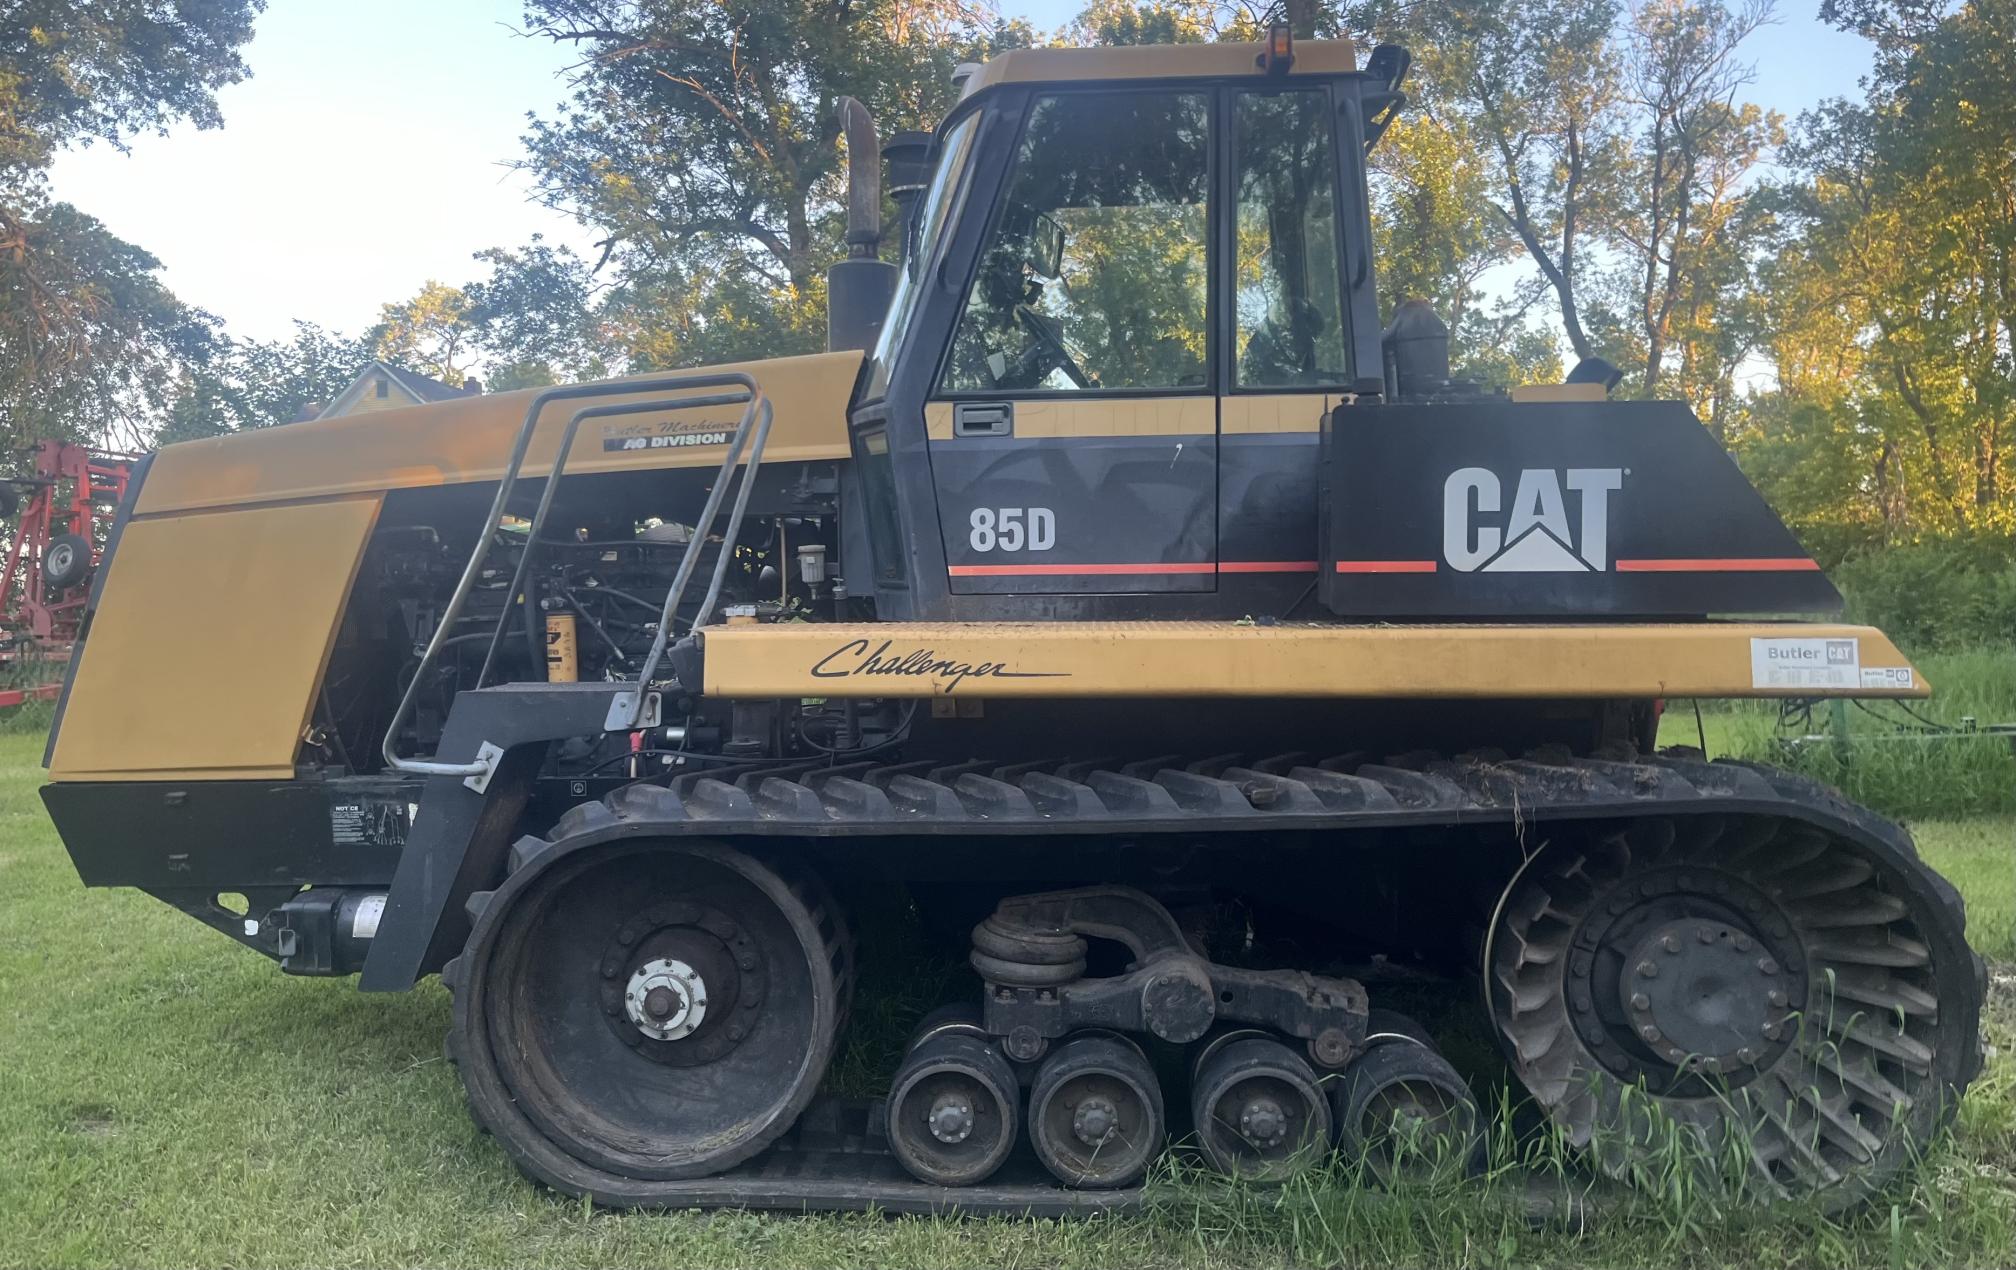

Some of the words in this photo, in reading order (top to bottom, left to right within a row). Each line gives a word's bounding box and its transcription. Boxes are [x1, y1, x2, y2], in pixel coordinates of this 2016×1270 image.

[603, 423, 651, 436] utler
[623, 437, 647, 450] AG
[651, 433, 726, 448] DIVISION
[969, 507, 1056, 552] 85D
[1443, 467, 1623, 573] CAT
[811, 639, 1073, 694] Challenger
[1767, 647, 1821, 660] Butler
[1828, 646, 1852, 661] CAT
